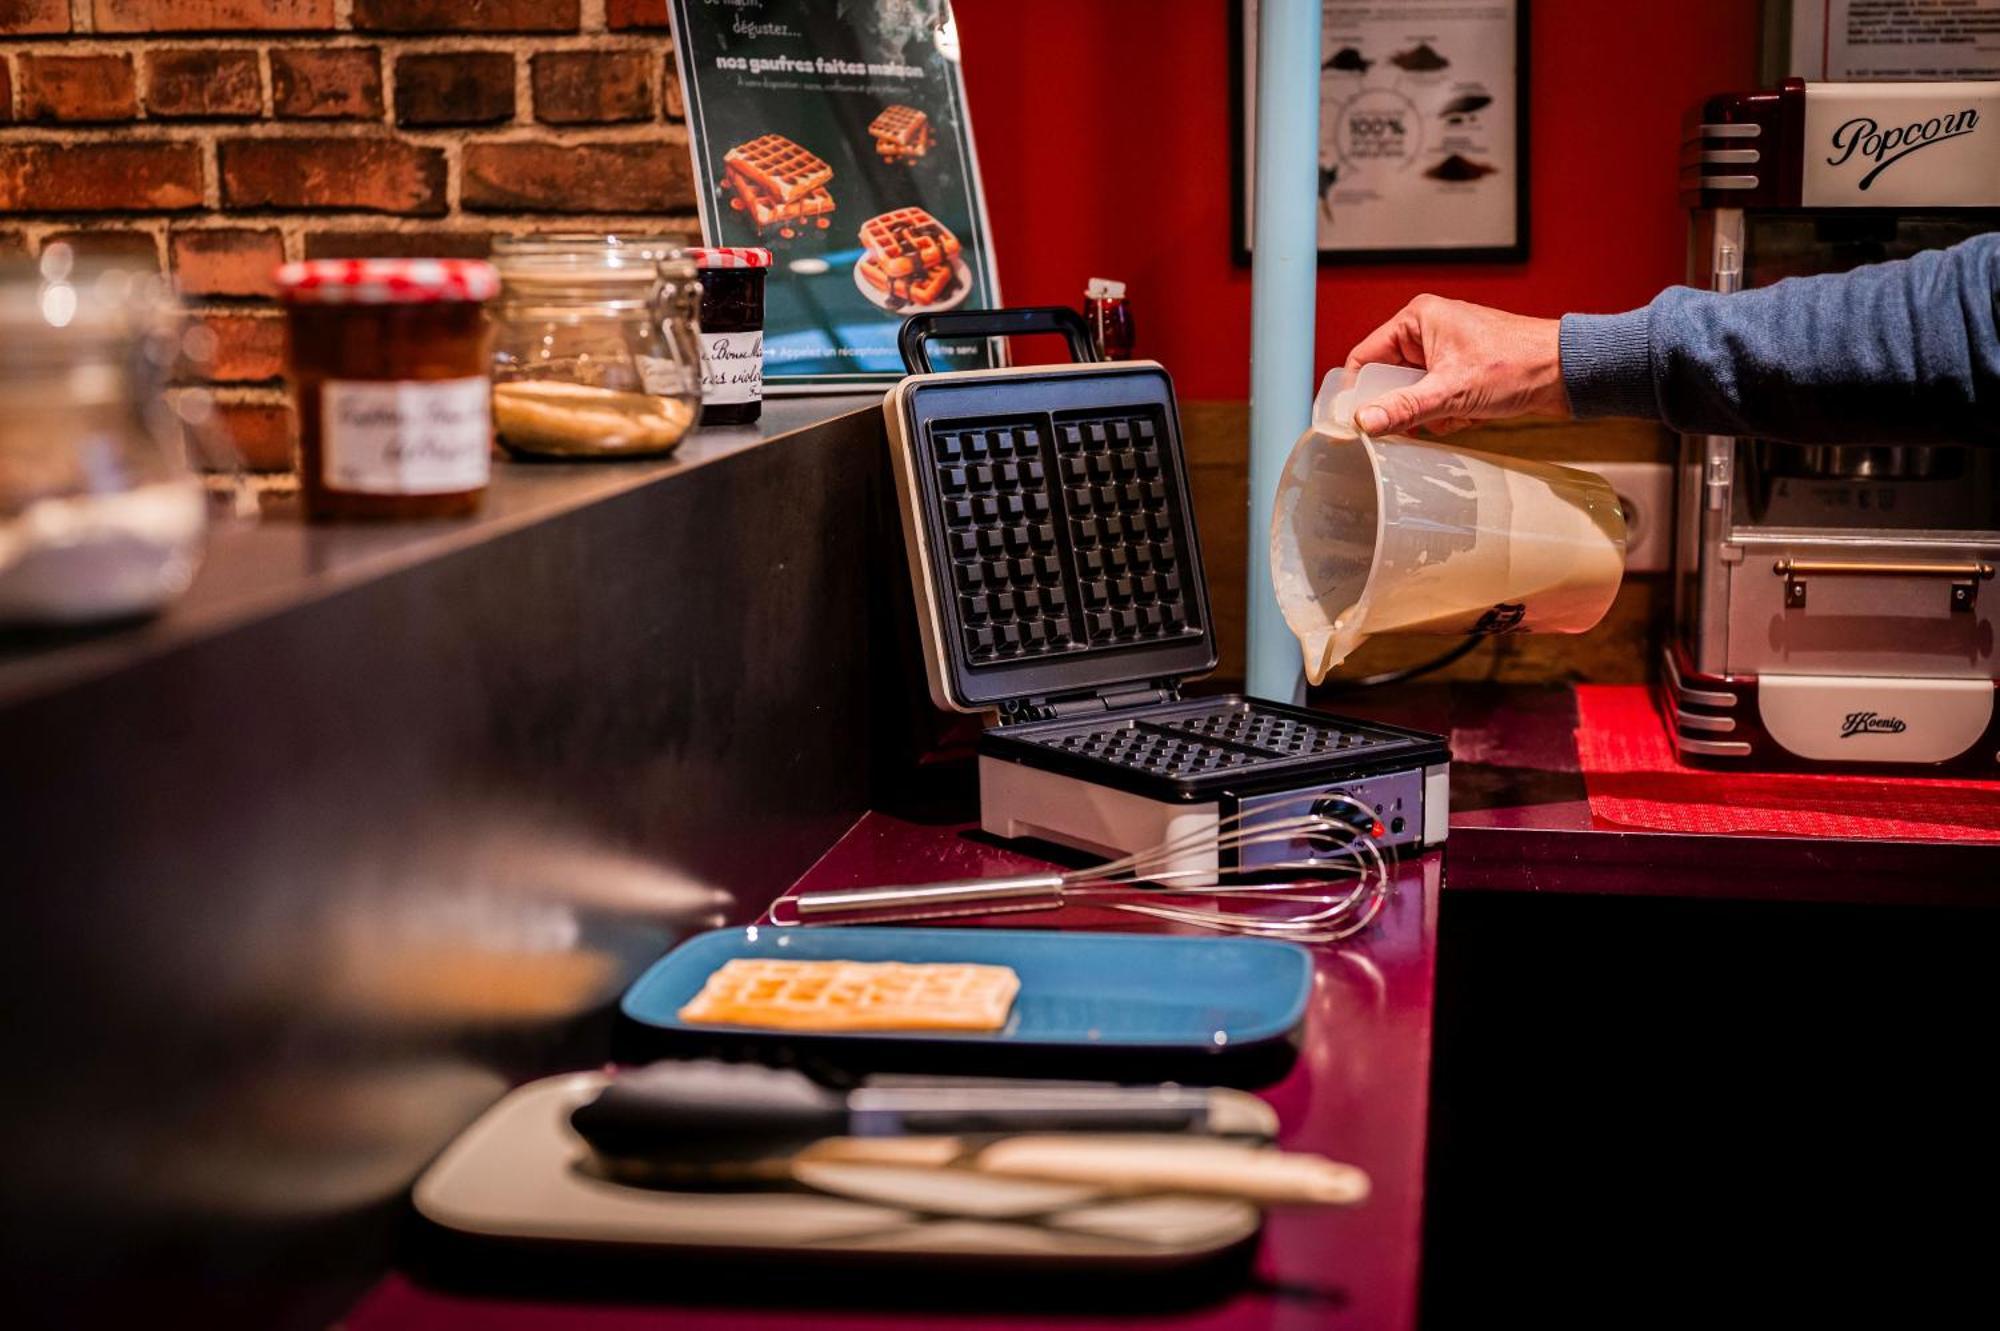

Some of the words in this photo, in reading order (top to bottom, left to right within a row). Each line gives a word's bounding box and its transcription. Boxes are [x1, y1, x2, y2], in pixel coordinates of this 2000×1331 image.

[715, 55, 748, 70] nos
[750, 54, 814, 75] gaufres
[815, 56, 867, 75] faites
[867, 60, 924, 78] maison
[1826, 108, 1981, 167] Popcorn
